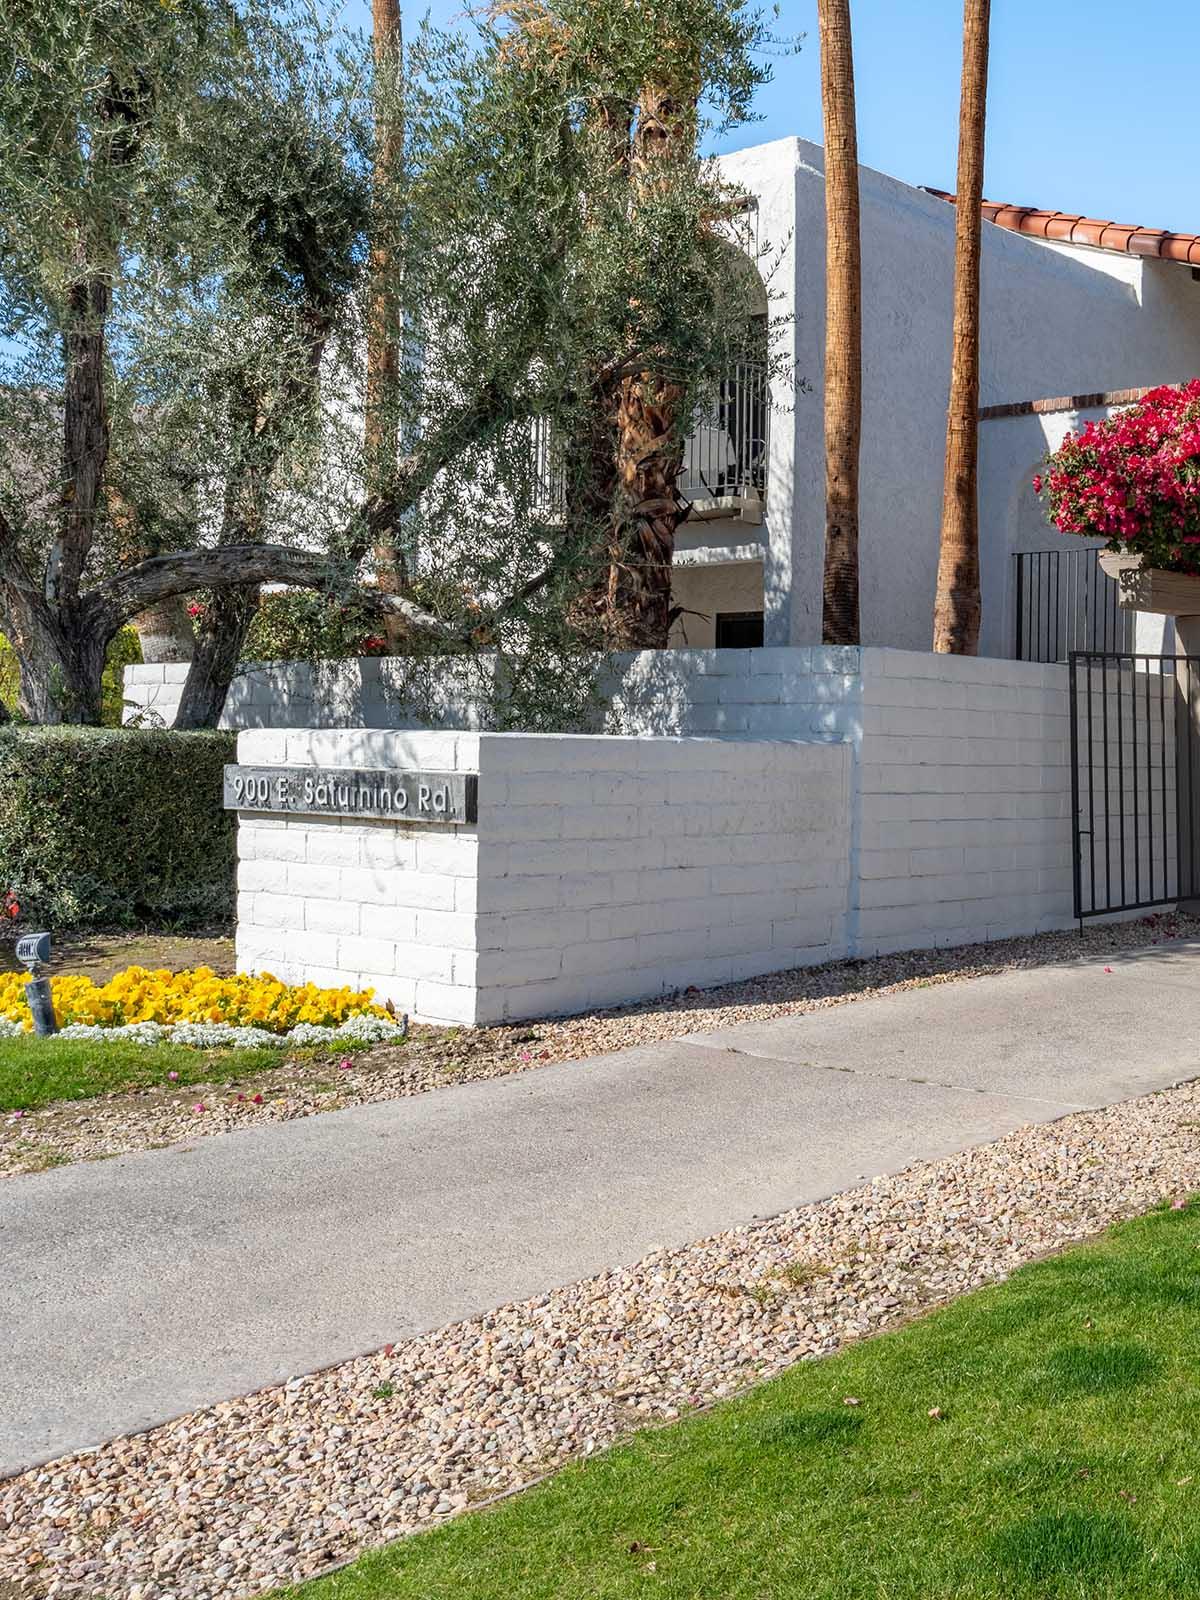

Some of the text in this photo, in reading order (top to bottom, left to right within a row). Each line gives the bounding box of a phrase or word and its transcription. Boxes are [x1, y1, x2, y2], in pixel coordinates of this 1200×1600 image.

[234, 776, 455, 812] 900 E. Saturnino Rd.
